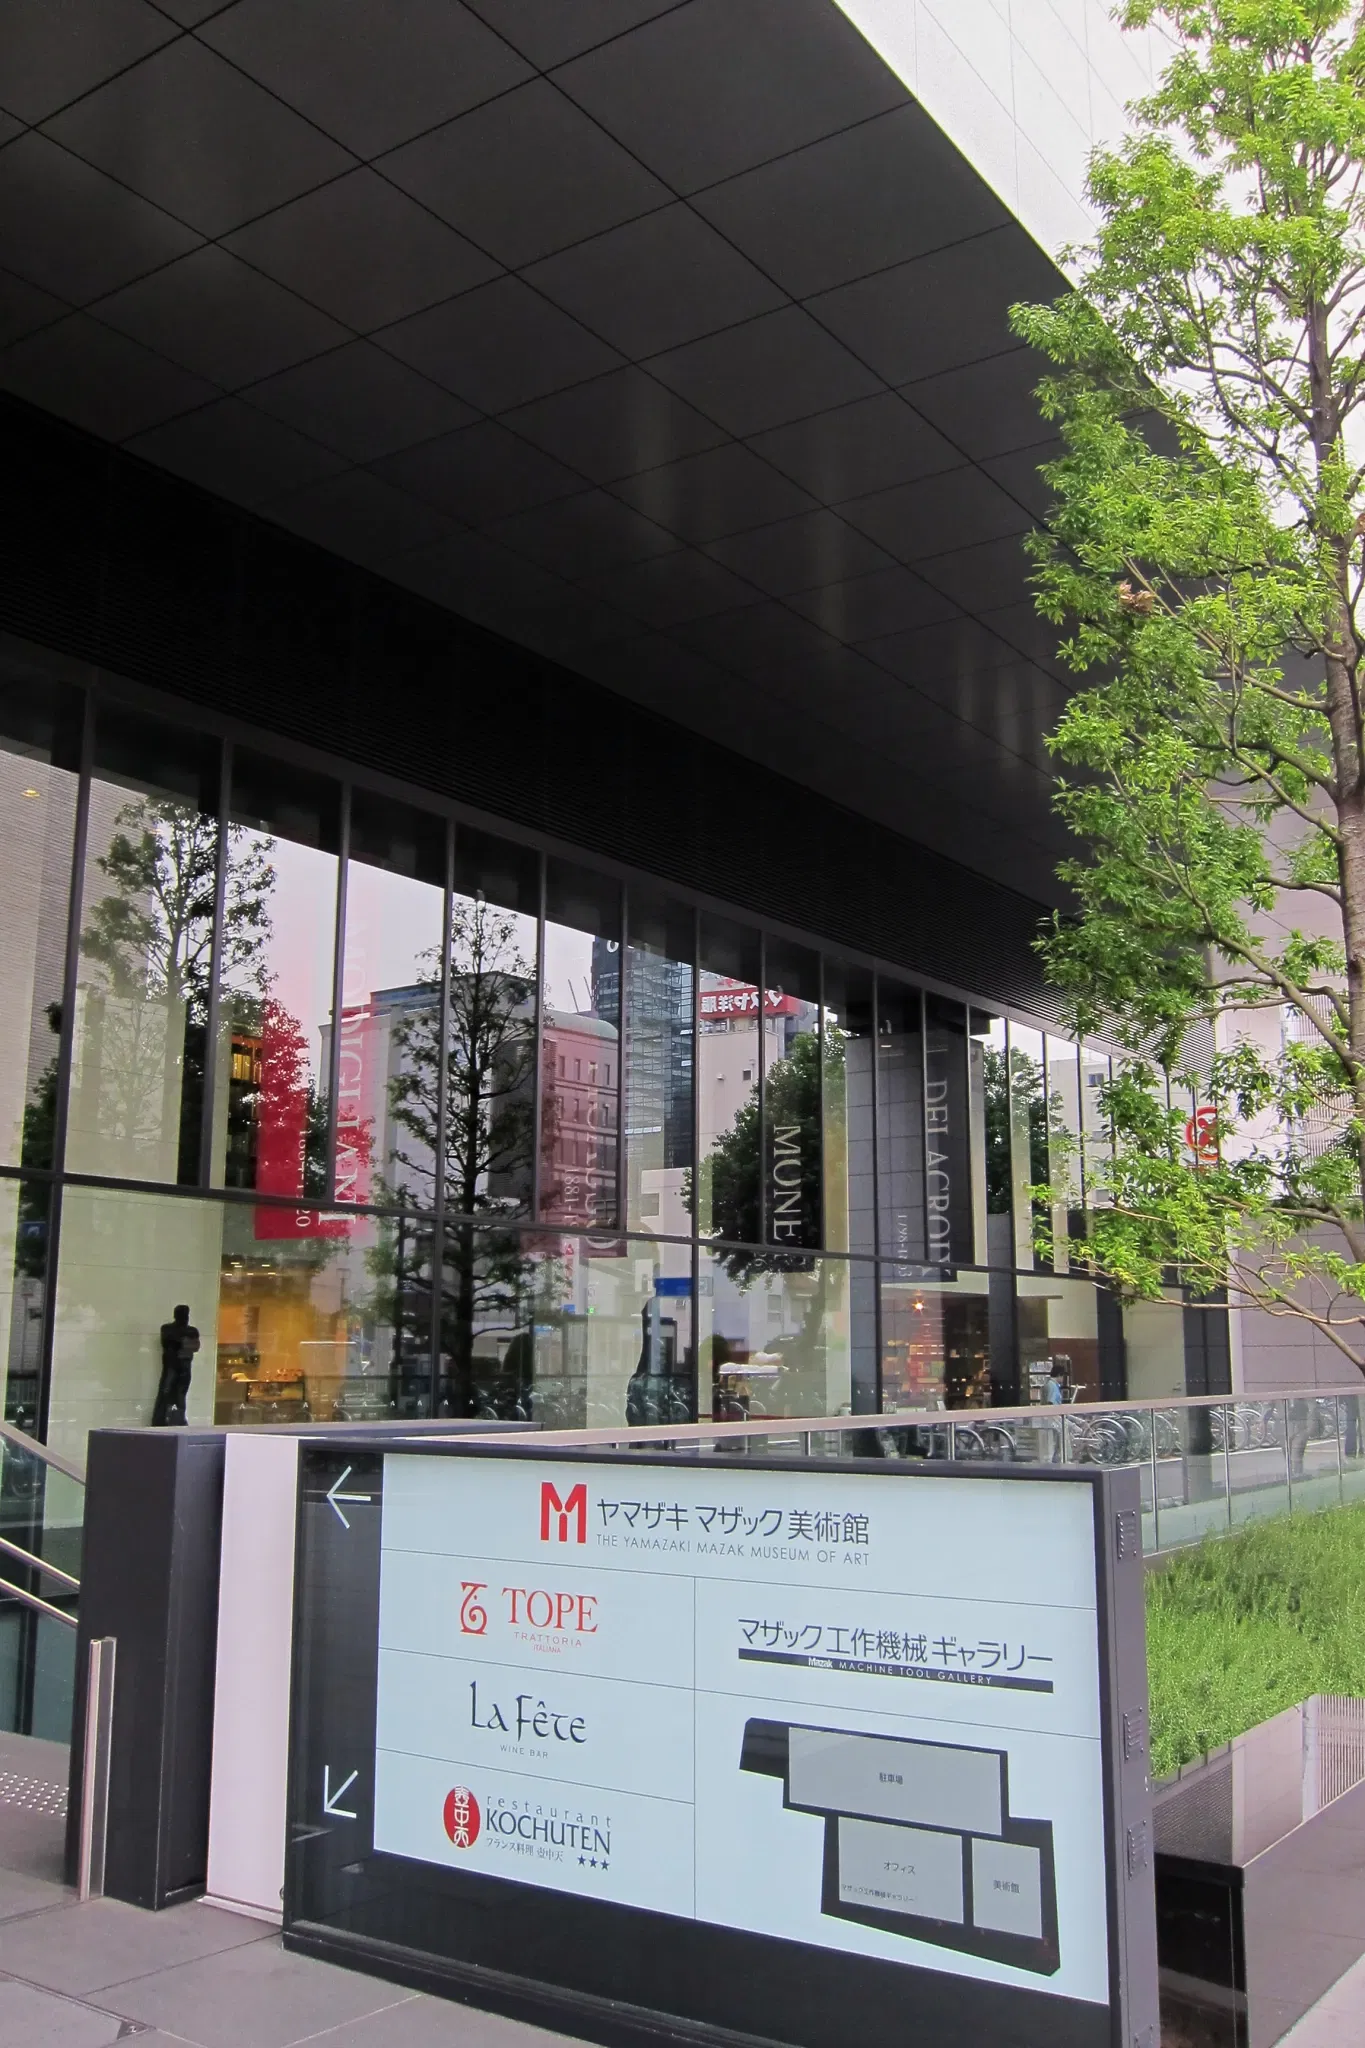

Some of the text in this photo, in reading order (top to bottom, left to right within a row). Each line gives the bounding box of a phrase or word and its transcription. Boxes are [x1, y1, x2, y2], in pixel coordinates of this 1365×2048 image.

[597, 1533, 869, 1566] THE YAMAZAKI MAZAK MUSEUM OF ART
[501, 1587, 599, 1633] TOPE
[514, 1631, 582, 1647] TRATTORIA
[808, 1657, 992, 1685] Mazak MACHINE TOOL GALLERY
[470, 1680, 587, 1744] La Fête
[500, 1743, 549, 1759] WINE BAR
[879, 1771, 904, 1785] 駐車場
[487, 1795, 612, 1828] restaurant
[486, 1807, 611, 1855] KOCHUTEN
[883, 1860, 916, 1876] オフィス
[993, 1878, 1021, 1894] 美術館
